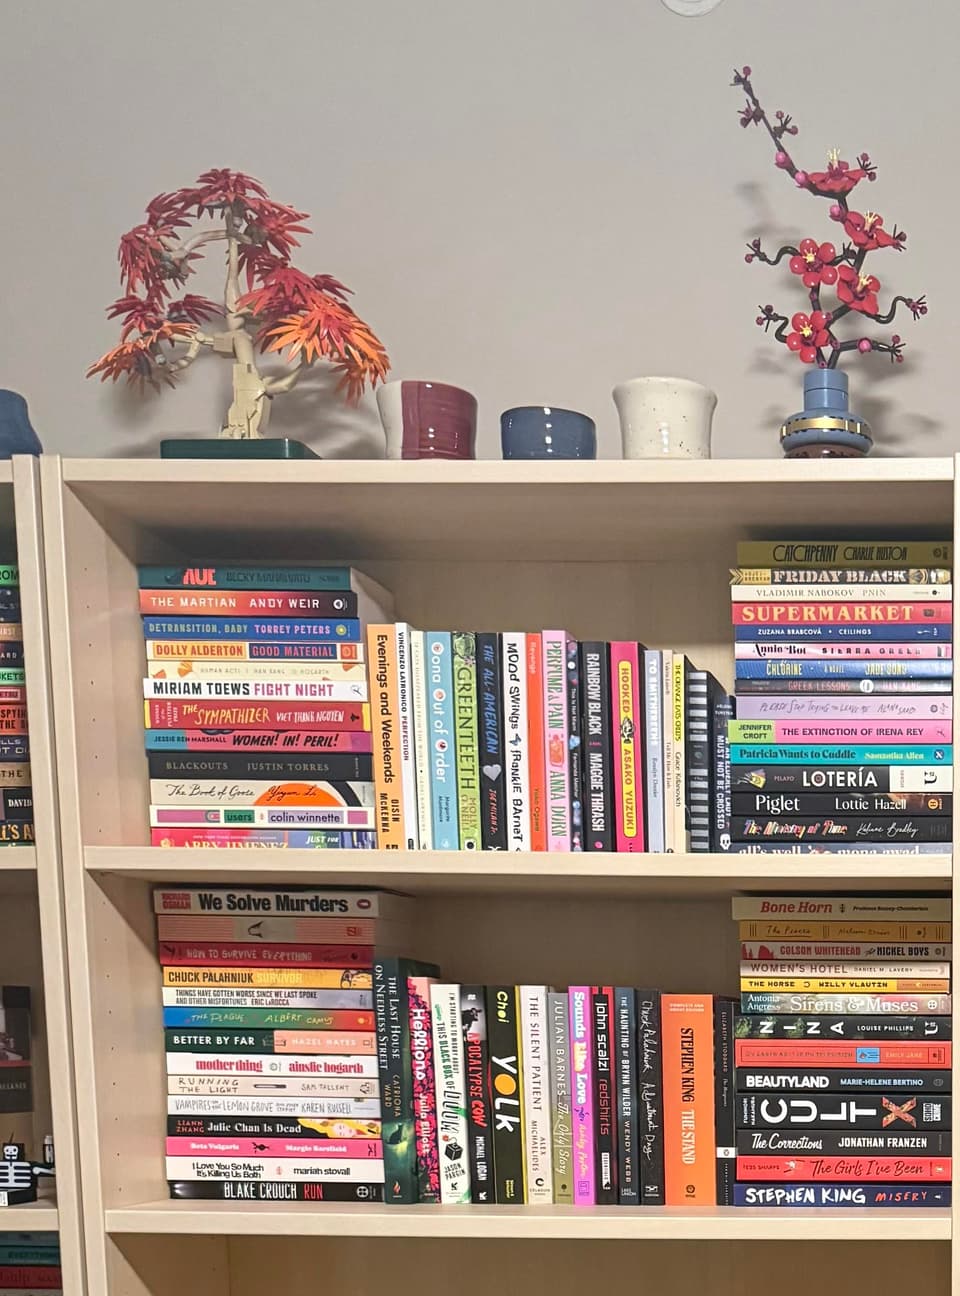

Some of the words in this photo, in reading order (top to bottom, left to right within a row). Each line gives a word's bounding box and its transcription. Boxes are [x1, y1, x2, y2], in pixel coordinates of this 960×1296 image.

[150, 597, 174, 607] THE
[180, 598, 236, 608] MARTIAN
[250, 598, 283, 608] ANDY
[288, 599, 320, 609] WEIR
[742, 606, 914, 622] SUPERMARKET
[156, 644, 188, 656] DOLLY
[191, 644, 244, 656] ALDERTON
[252, 646, 280, 656] GOOD
[284, 646, 334, 657] MATERIAL
[376, 634, 390, 688] Evenings
[153, 682, 202, 695] MIRIAM
[206, 682, 250, 696] TOEWS
[254, 684, 290, 696] FIGHT
[296, 684, 334, 696] NIGHT
[621, 667, 630, 713] HOOKED
[379, 692, 390, 715] and
[456, 667, 476, 790] GREENTEETH
[782, 728, 799, 736] THE
[802, 728, 858, 736] EXTINCTION
[860, 728, 873, 736] OF
[876, 728, 904, 736] IRENA
[906, 728, 924, 736] REY
[380, 720, 393, 783] Weekends
[623, 749, 632, 786] ASAKO
[803, 767, 877, 787] LOTERÍA
[624, 792, 634, 830] YUZUKI
[755, 795, 800, 814] Piglet
[835, 798, 869, 810] Lottie
[875, 798, 907, 810] Hazell
[198, 893, 223, 911] We
[227, 894, 272, 911] Solve
[275, 895, 348, 912] Murders
[760, 902, 796, 913] Bone
[799, 902, 833, 914] Horn
[173, 1036, 213, 1045] BETTER
[216, 1036, 230, 1045] BY
[234, 1036, 255, 1046] FAR
[680, 1027, 695, 1076] STEPHEN
[682, 1079, 695, 1103] KING
[746, 1075, 829, 1088] BEAUTYLAND
[681, 1110, 695, 1129] THE
[682, 1132, 696, 1165] STAND
[838, 1136, 884, 1147] JONATHAN
[887, 1137, 927, 1148] FRANZEN
[224, 1183, 256, 1199] BLAKE
[259, 1183, 297, 1199] CROUCH
[303, 1184, 323, 1199] RUN
[746, 1187, 816, 1204] STEPHEN
[821, 1187, 866, 1204] KING
[875, 1191, 927, 1202] MISERY
